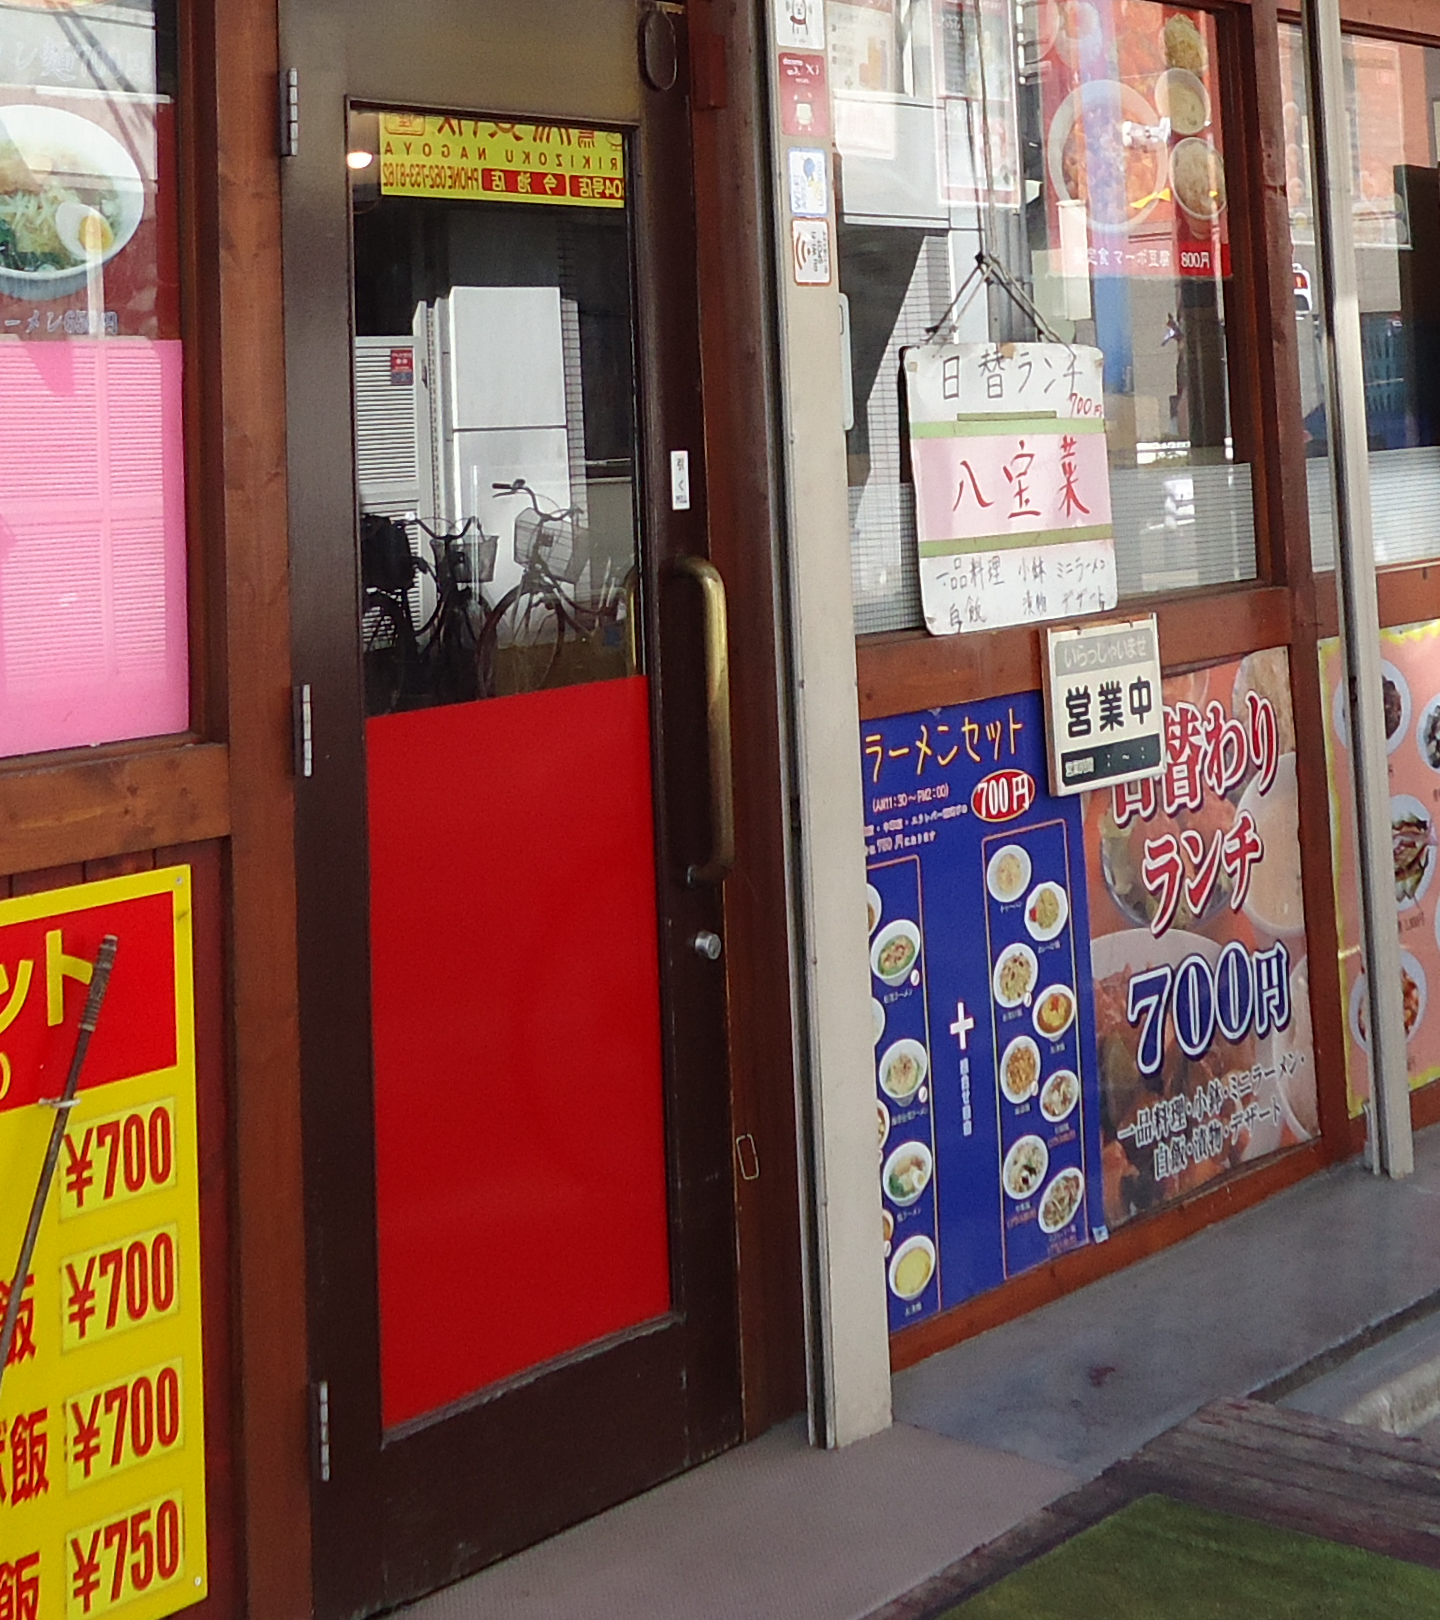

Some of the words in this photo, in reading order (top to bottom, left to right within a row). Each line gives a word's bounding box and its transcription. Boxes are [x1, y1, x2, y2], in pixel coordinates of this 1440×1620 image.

[943, 349, 1083, 400] 日替ランチ
[953, 435, 1091, 519] 八宝菜
[1064, 638, 1148, 669] いらっしゃいませ
[865, 707, 1023, 782] ラーメンセット
[1065, 675, 1152, 740] 営業中
[978, 773, 1031, 818] 700円
[1142, 811, 1262, 935] ランチ
[1127, 940, 1292, 1076] 700円
[64, 1105, 173, 1209] ¥700
[66, 1231, 176, 1340] ¥700
[70, 1366, 180, 1479] ¥700
[70, 1498, 180, 1614] ¥750
